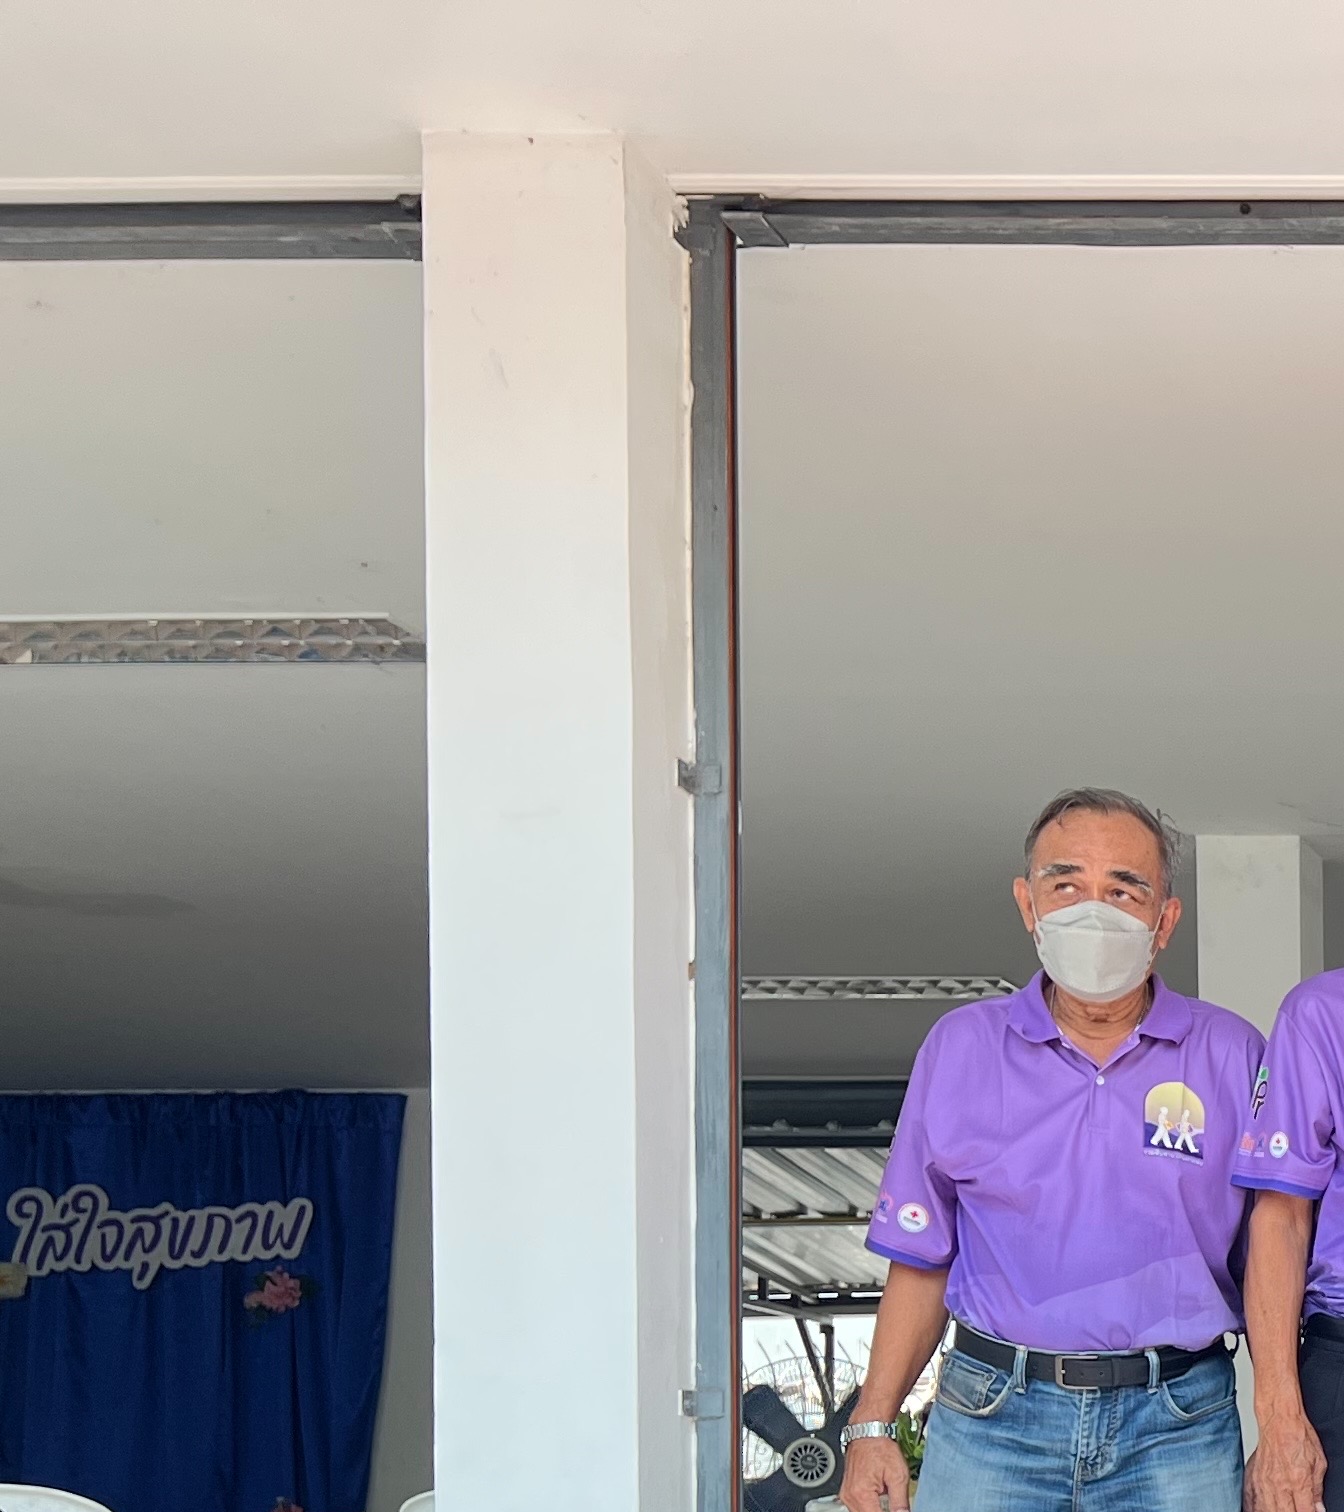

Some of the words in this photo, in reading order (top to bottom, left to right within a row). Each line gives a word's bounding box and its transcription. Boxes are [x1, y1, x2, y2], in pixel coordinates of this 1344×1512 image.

[12, 1188, 309, 1283] ใส่ใจสุขภาพ
